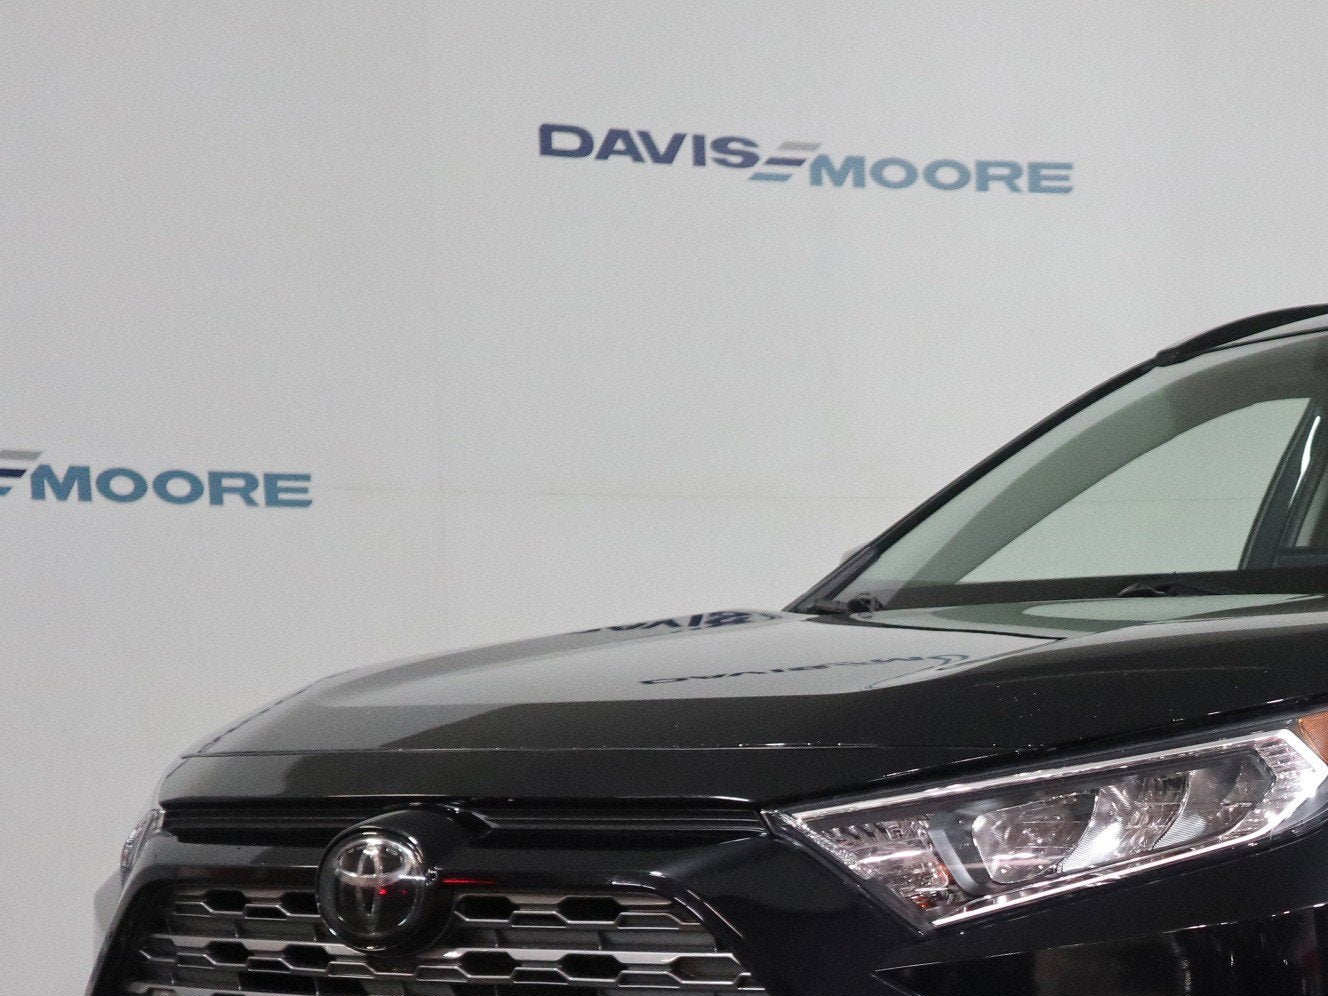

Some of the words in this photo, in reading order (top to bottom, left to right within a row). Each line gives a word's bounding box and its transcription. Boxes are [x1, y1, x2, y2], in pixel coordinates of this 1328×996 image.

[537, 122, 760, 168] DAVIS
[809, 154, 1075, 194] MOORE
[30, 464, 313, 508] MOORE
